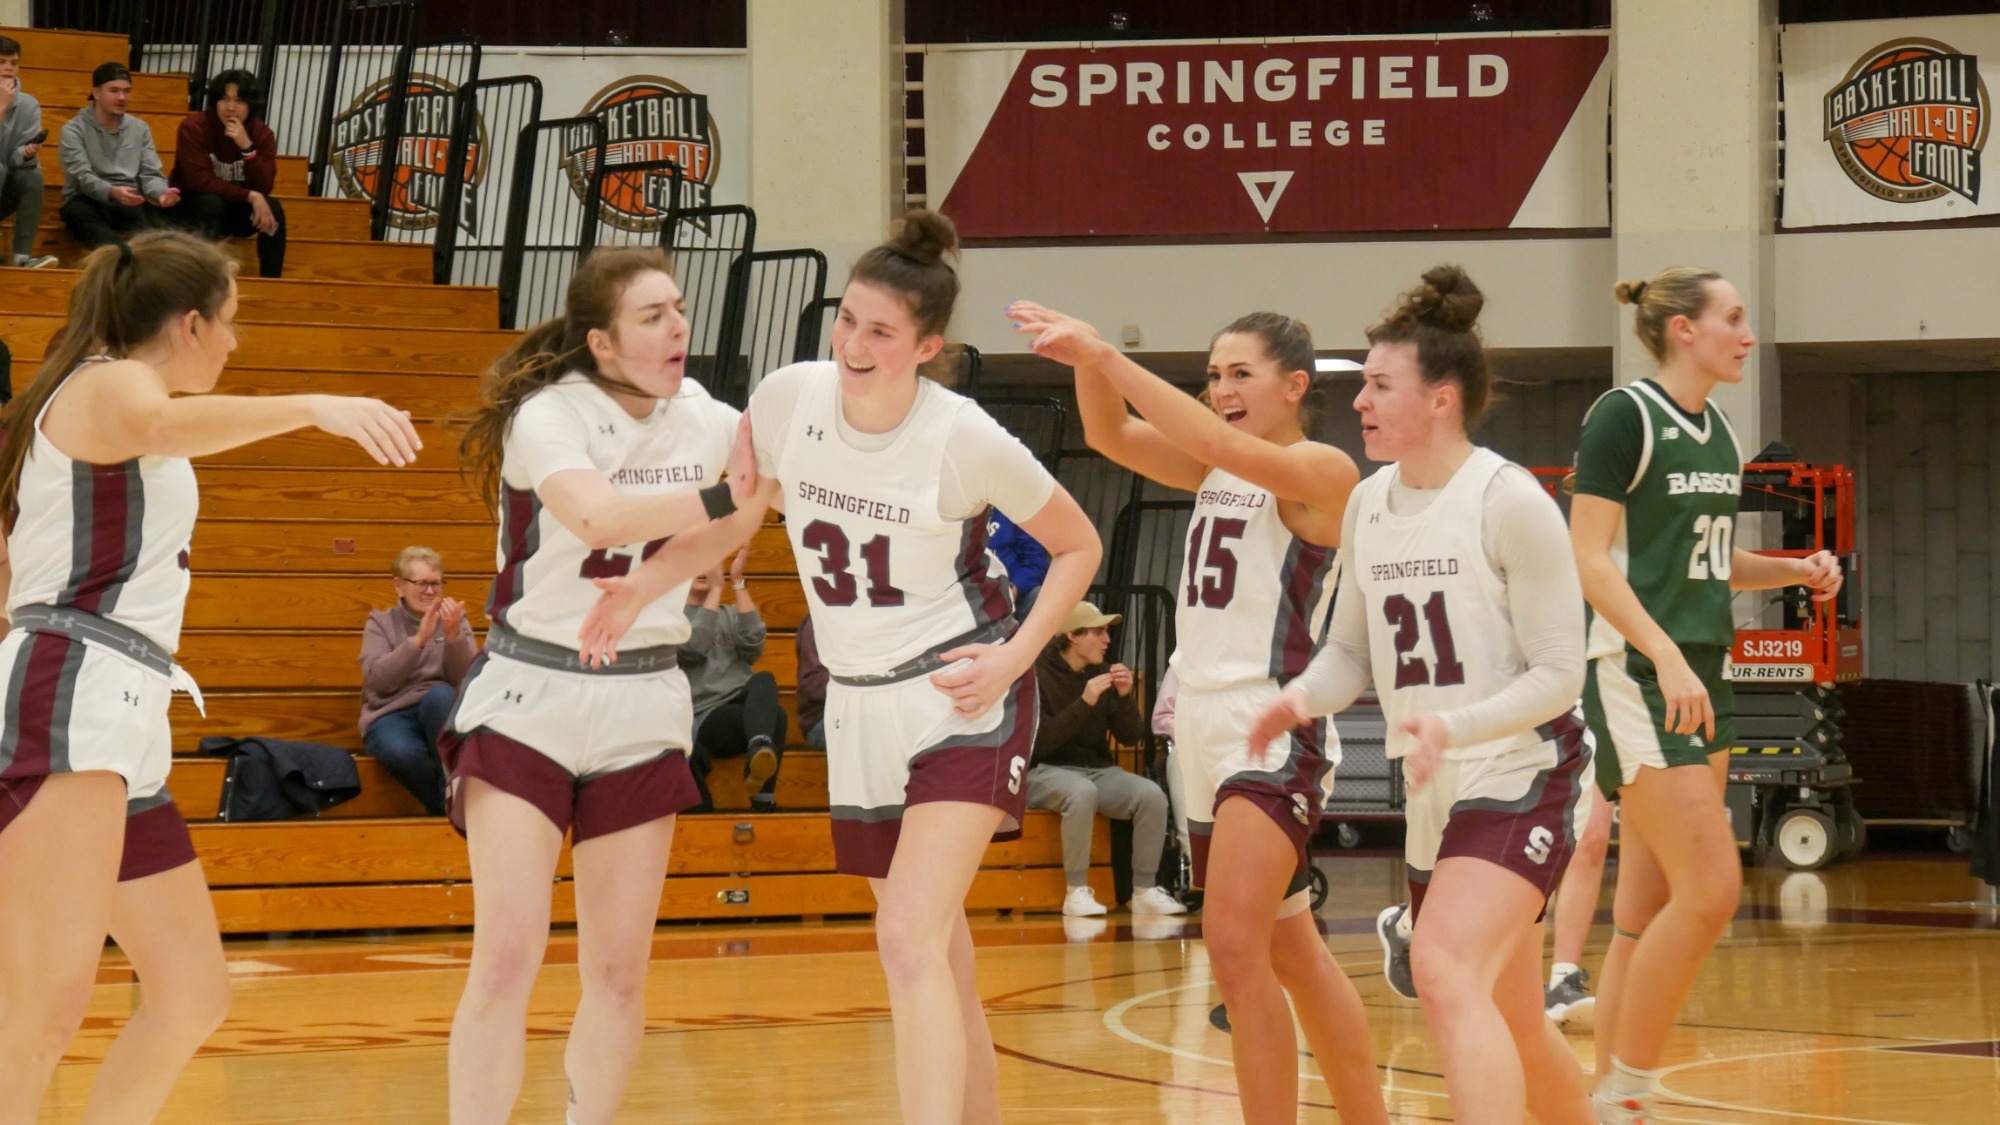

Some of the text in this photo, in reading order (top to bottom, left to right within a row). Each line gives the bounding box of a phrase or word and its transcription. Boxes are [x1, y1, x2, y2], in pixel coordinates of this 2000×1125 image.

[1029, 54, 1509, 107] SPRINGFIELD
[1833, 59, 1972, 122] BASKETBALL
[1147, 119, 1386, 150] COLLEGE
[1889, 107, 1973, 144] HALL OF
[1837, 145, 1895, 198] SPRINGFIELD
[1915, 141, 1974, 196] FAME
[799, 481, 910, 524] SPRINGFIELD
[802, 518, 905, 608] 31
[1186, 516, 1249, 610] 15
[1371, 559, 1459, 581] SPRINGFIELD
[1688, 514, 1733, 581] 20
[1383, 591, 1465, 690] 21
[1743, 640, 1803, 657] SJ3219
[1008, 755, 1026, 796] S
[1523, 826, 1554, 865] S
